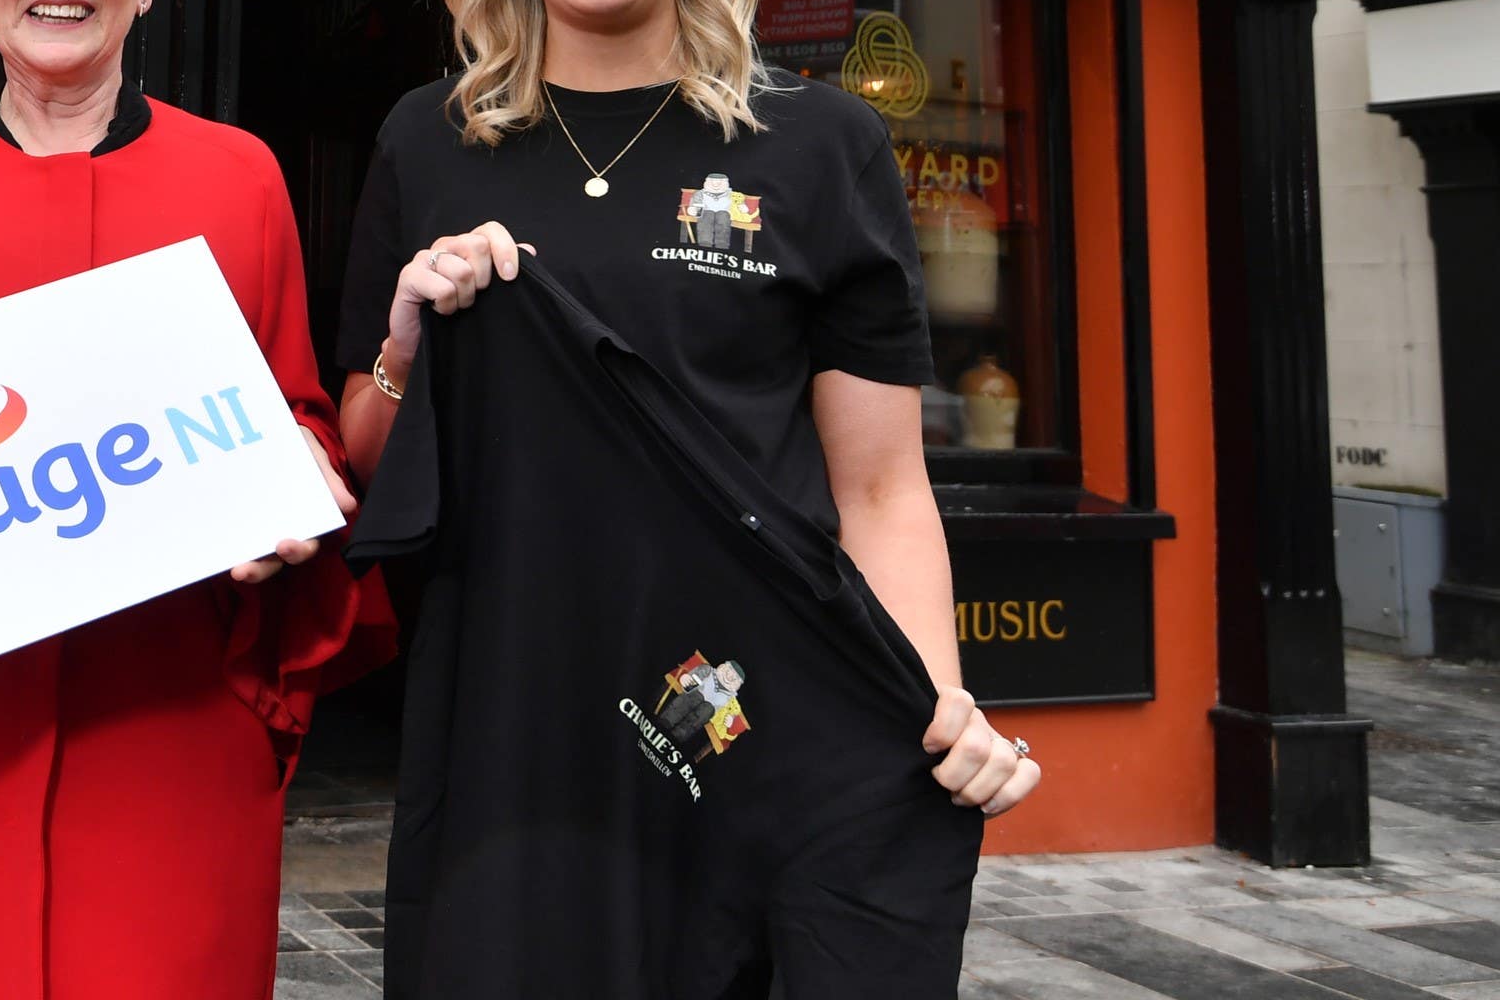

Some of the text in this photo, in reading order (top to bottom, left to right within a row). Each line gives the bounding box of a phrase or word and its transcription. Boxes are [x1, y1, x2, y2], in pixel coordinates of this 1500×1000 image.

[651, 248, 777, 277] CHARLIE'S BAR
[165, 386, 262, 465] NI
[619, 698, 702, 803] CHARLIE'S BAR
